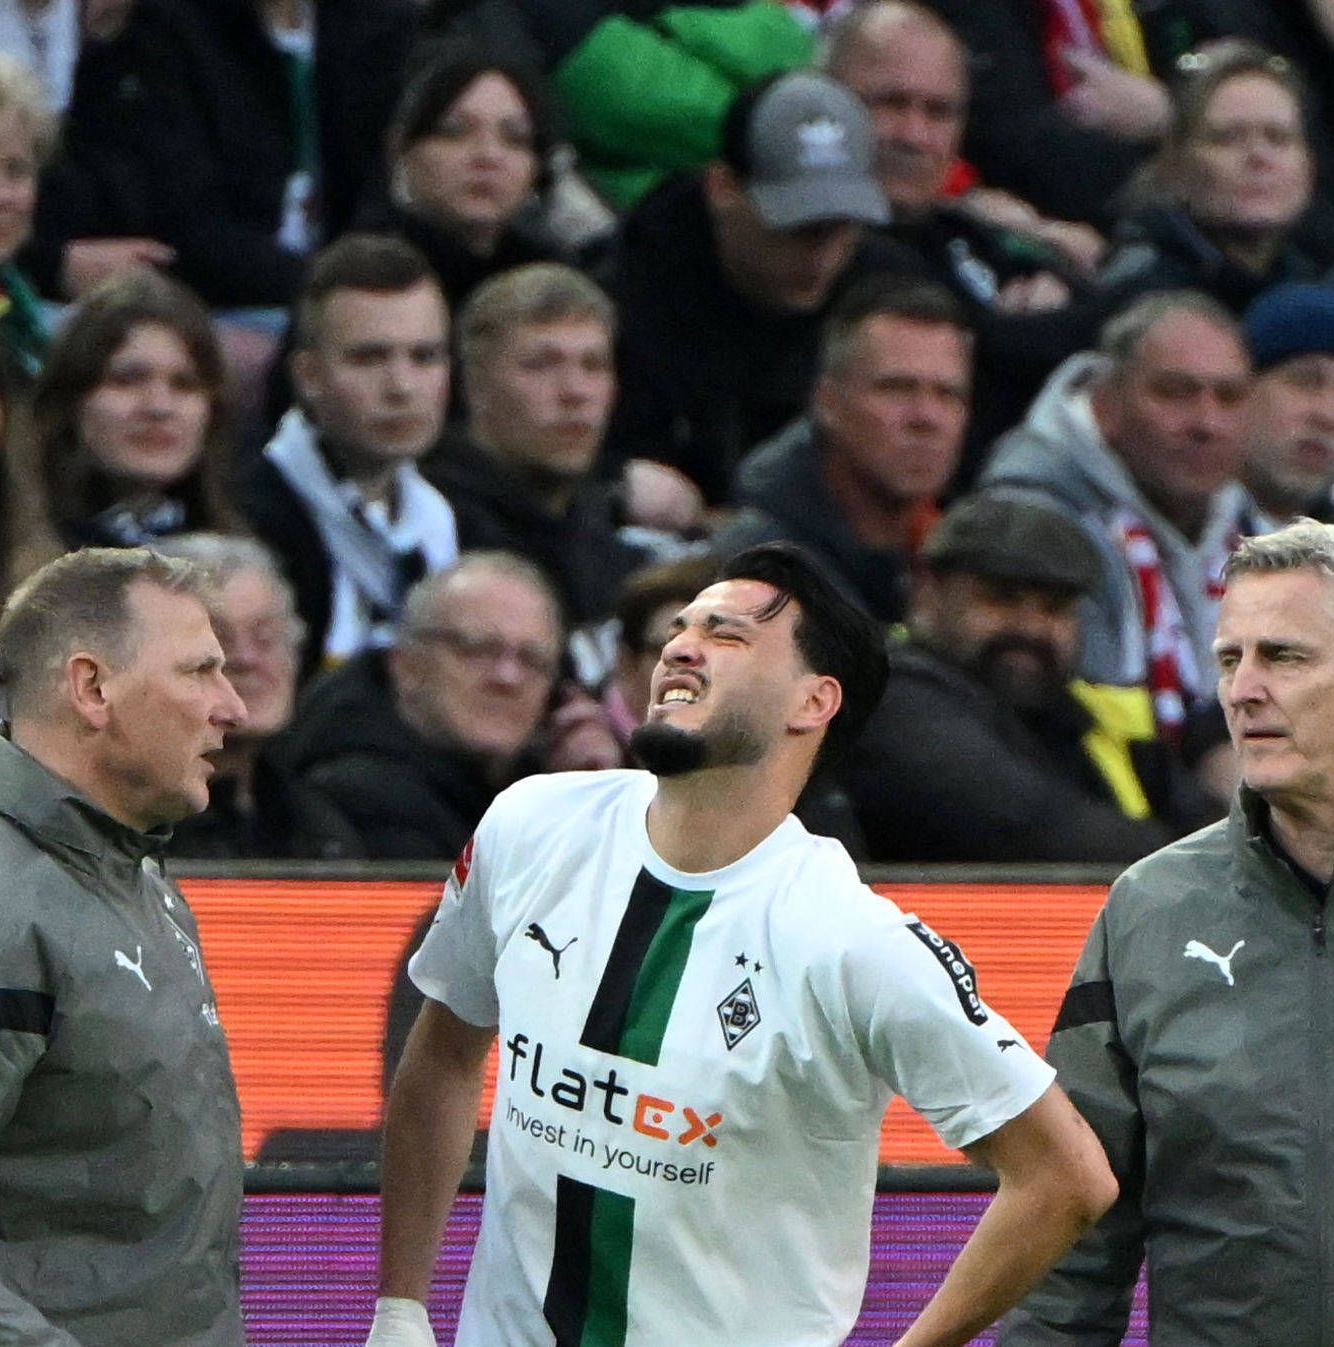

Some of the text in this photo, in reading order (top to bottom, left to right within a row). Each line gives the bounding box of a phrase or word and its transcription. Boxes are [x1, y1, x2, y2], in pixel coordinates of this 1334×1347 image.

[507, 1033, 723, 1147] flatex
[573, 1128, 595, 1158] in
[602, 1144, 715, 1185] yourself
